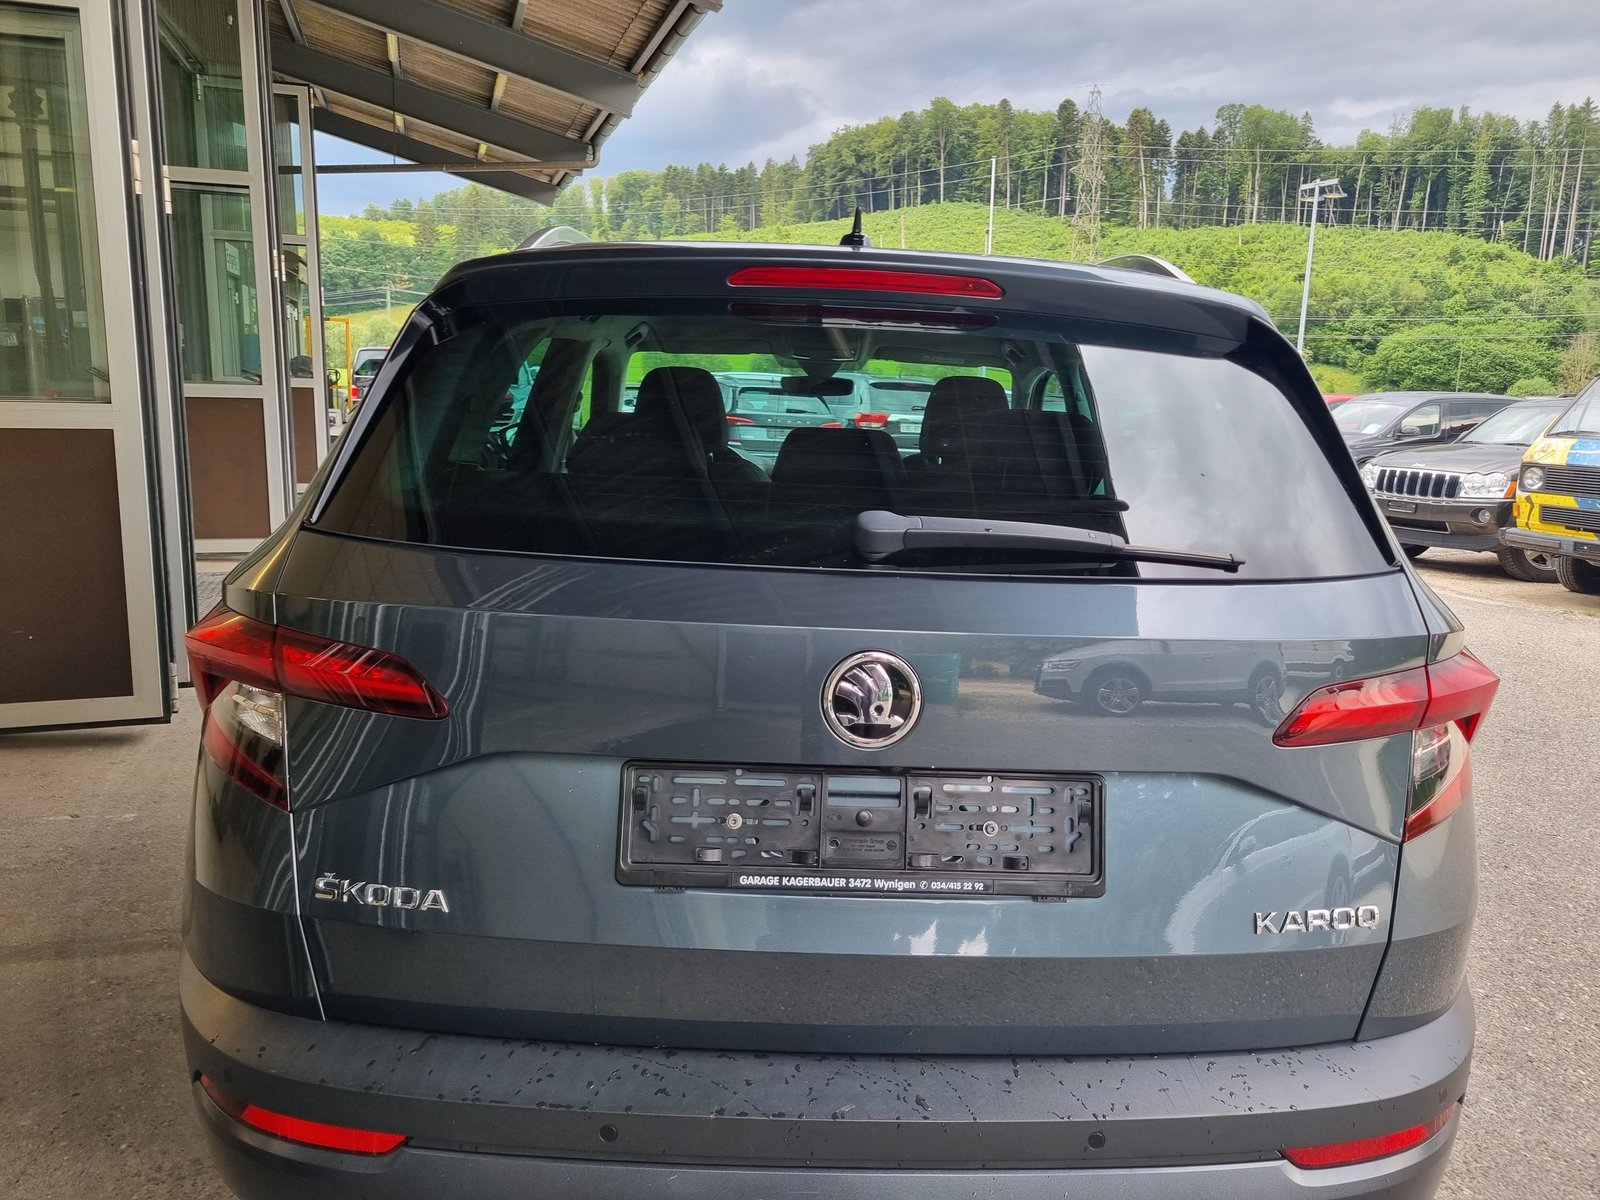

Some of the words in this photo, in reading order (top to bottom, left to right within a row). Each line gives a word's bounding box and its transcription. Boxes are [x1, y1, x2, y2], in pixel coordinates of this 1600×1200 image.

[314, 872, 449, 913] ŠKODA
[739, 875, 780, 886] GARAGE
[782, 876, 847, 888] KAGERBAUER
[848, 878, 872, 888] 3472
[874, 879, 916, 891] Wynigen
[930, 881, 962, 890] 034/415
[963, 882, 973, 891] 22
[974, 882, 985, 891] 92
[1254, 905, 1380, 935] KAROQ
